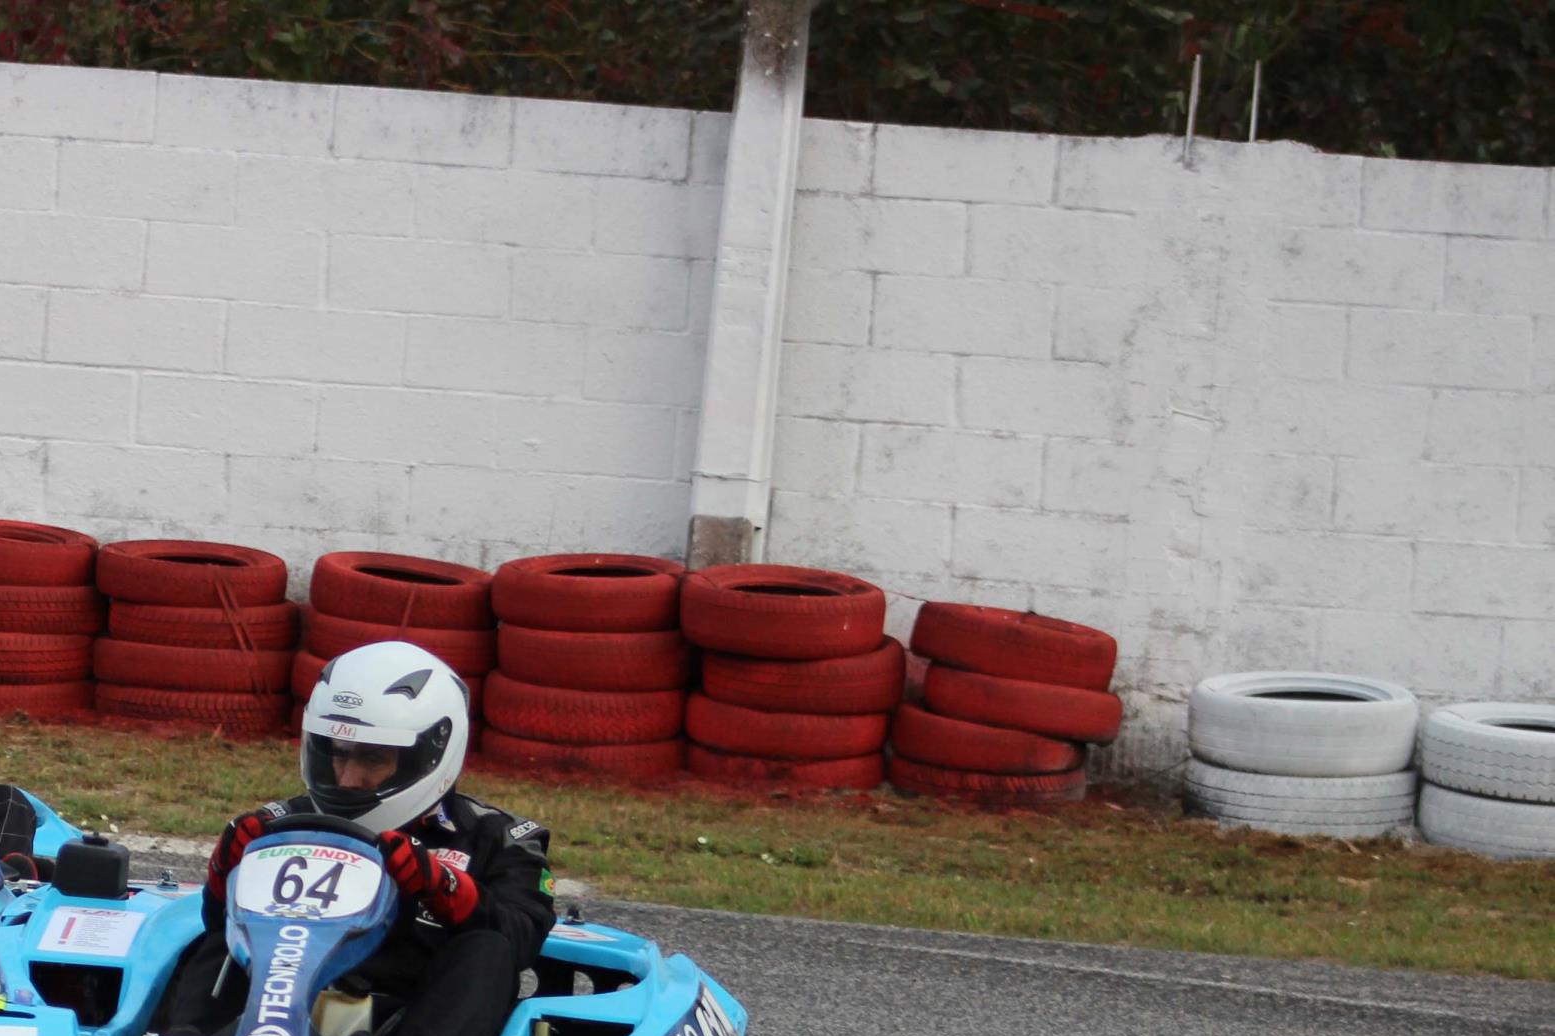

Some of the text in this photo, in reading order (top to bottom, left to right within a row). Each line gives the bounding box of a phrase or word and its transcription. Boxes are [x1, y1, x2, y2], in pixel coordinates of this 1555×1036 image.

[256, 847, 362, 864] EUROINDY
[272, 856, 344, 909] 64
[258, 924, 310, 1024] TECNIROLO
